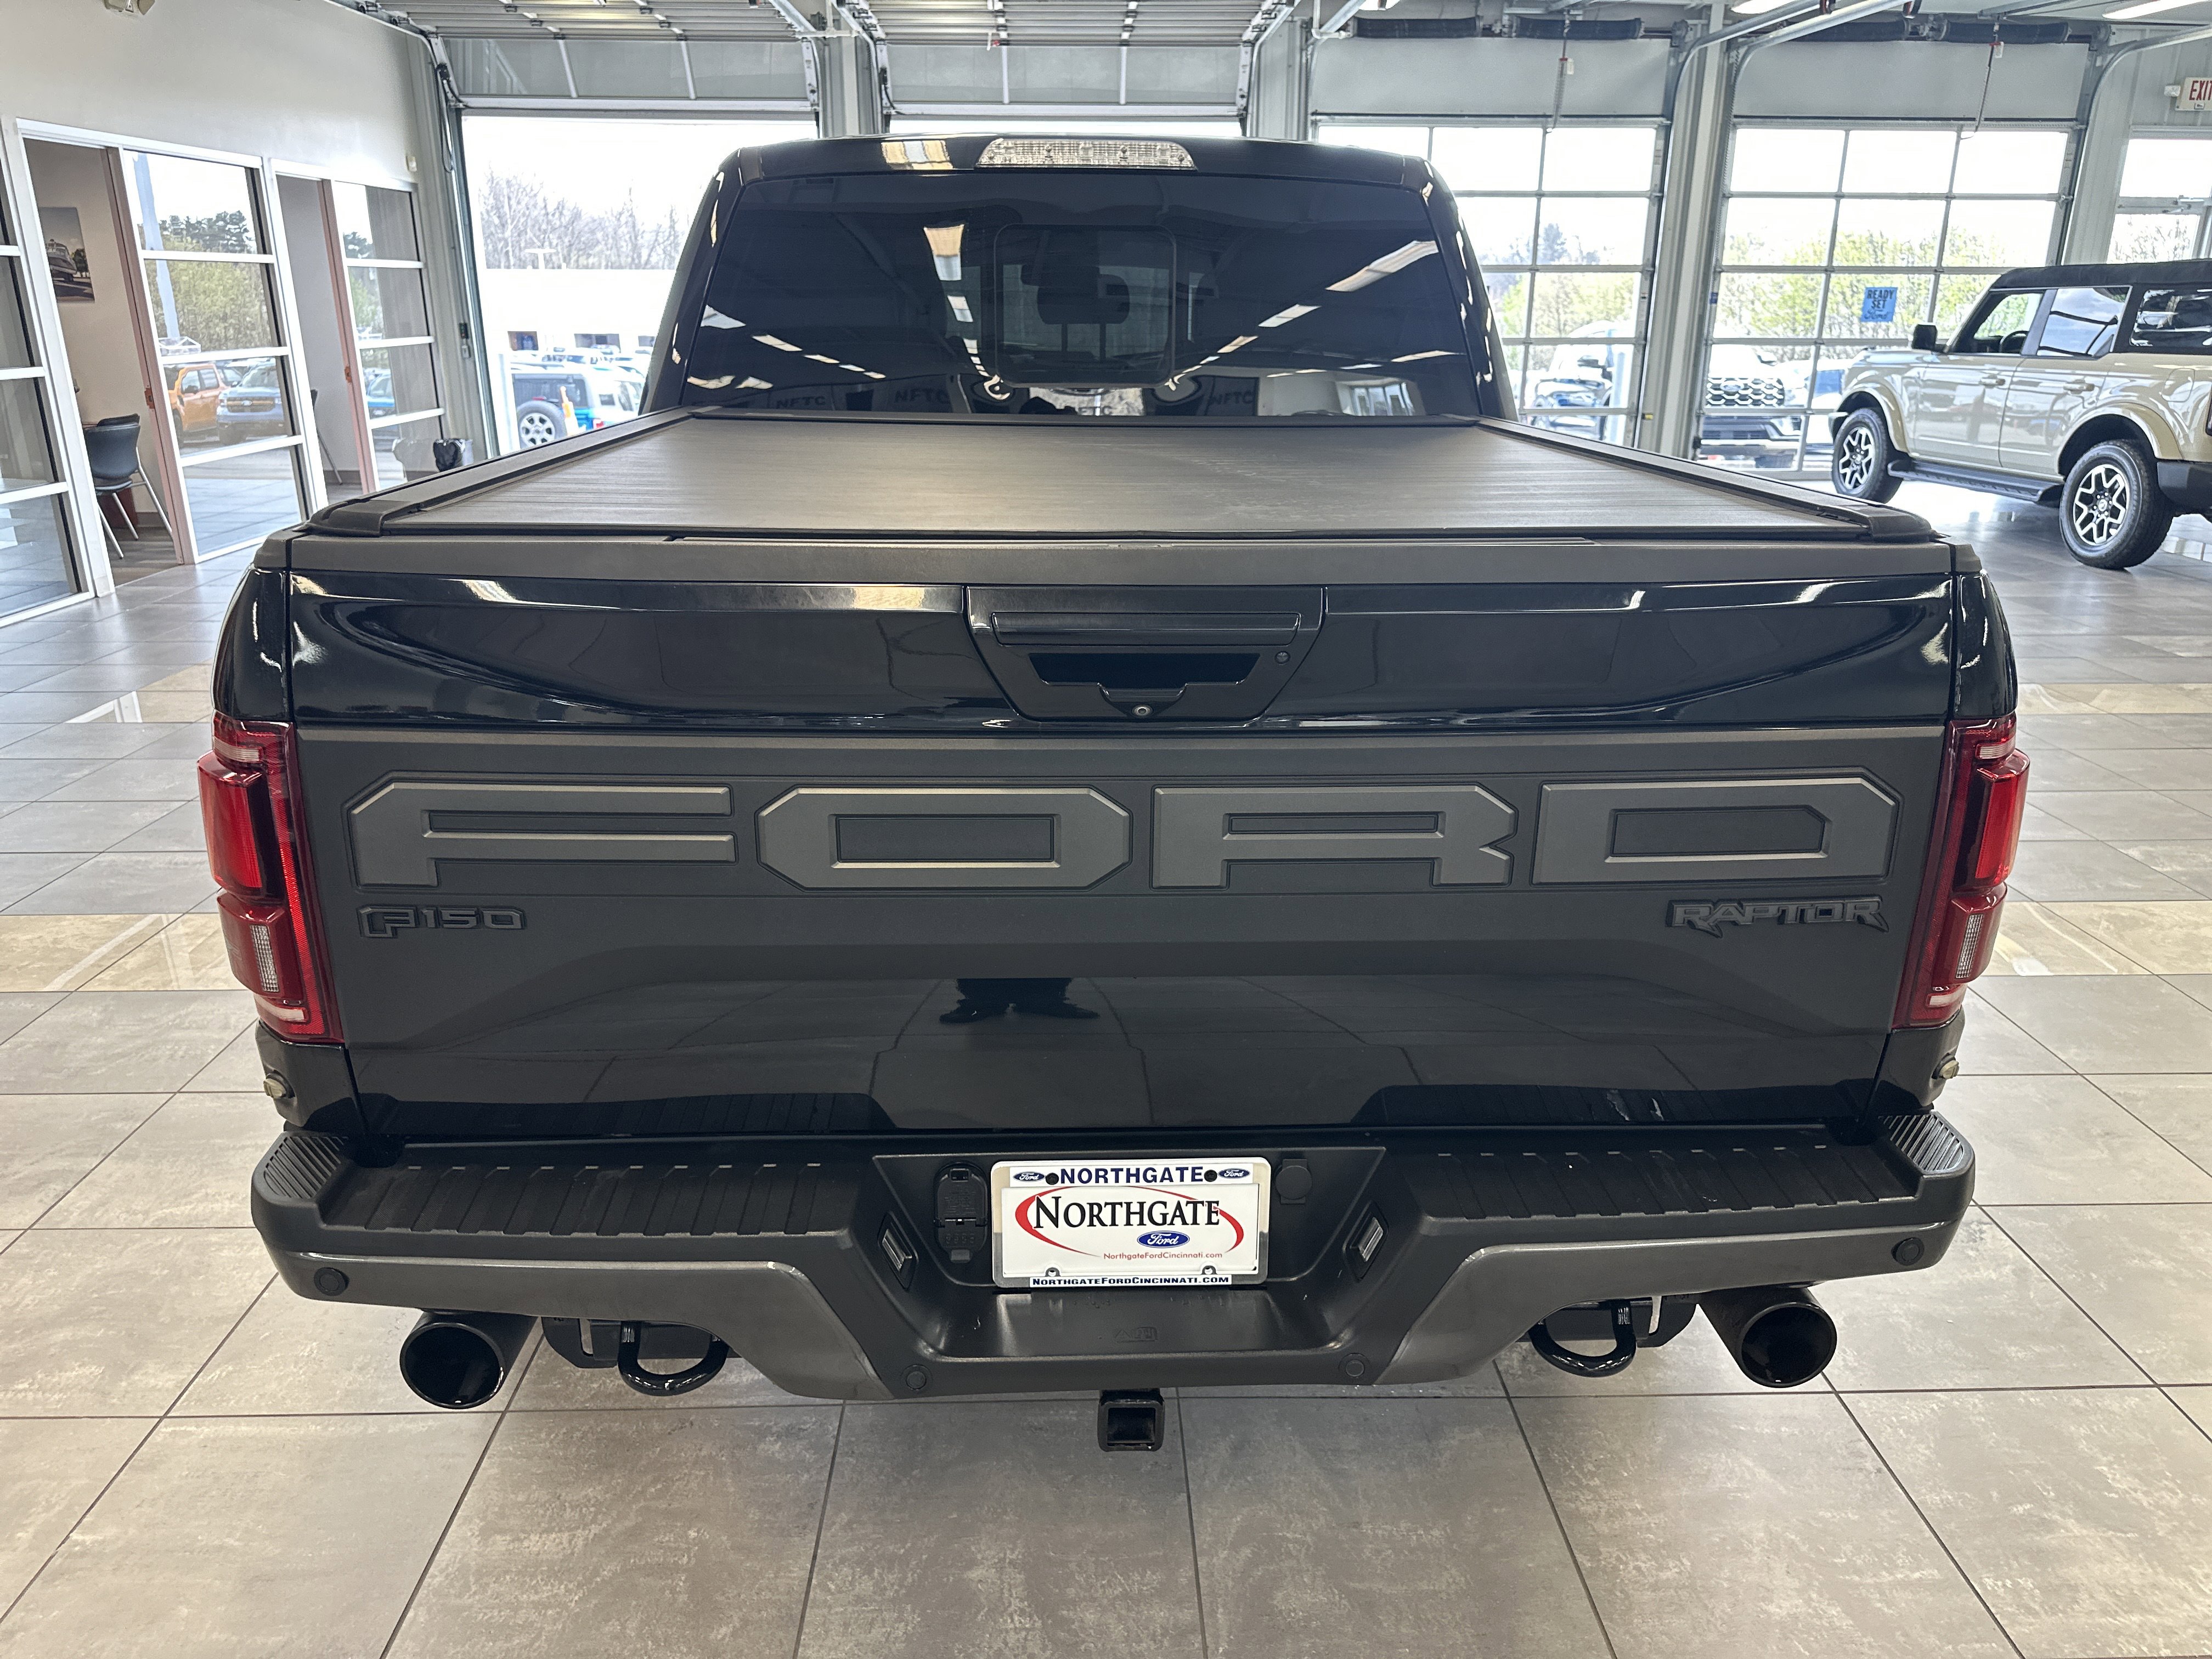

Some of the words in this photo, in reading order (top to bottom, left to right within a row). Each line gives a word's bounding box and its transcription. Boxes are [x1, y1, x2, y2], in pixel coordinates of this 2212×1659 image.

[1867, 290, 1894, 299] READY
[1871, 300, 1887, 309] SET
[349, 776, 1897, 890] FORD
[1666, 895, 1889, 938] RAPTOR
[1060, 1166, 1203, 1184] NORTHGATE
[1034, 1197, 1220, 1228] NORTHGATE
[1103, 1252, 1223, 1261] NorthgateFordCincinnati.com
